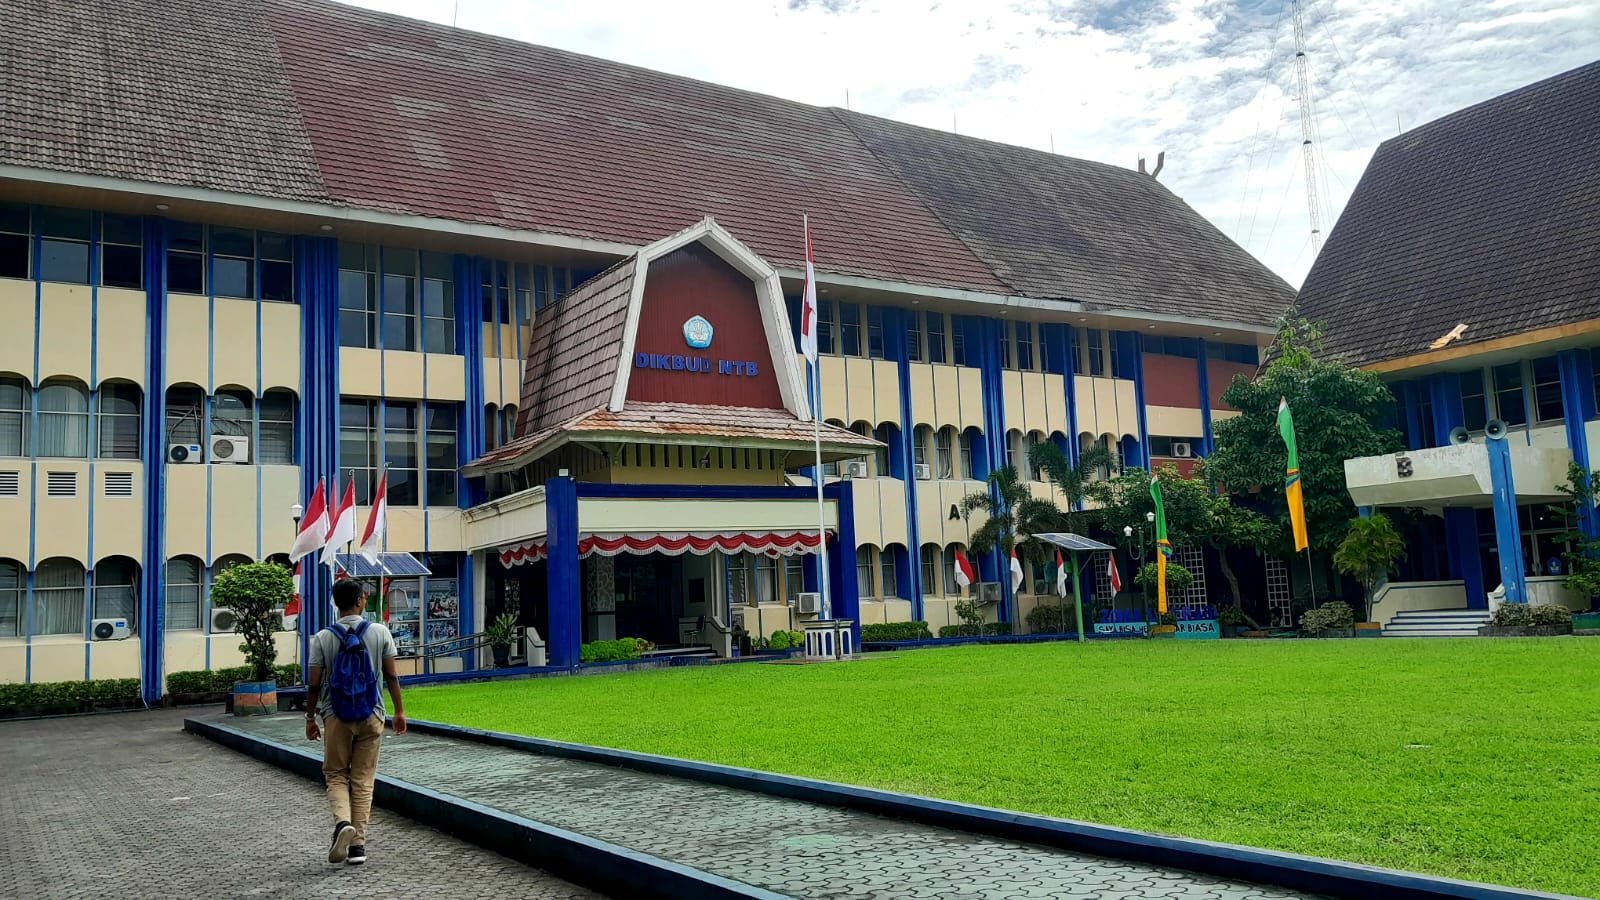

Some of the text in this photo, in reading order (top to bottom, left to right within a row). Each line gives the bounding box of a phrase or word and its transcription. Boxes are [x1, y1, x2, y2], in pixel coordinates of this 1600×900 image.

[635, 352, 759, 377] DIKBUD NTB
[1395, 456, 1414, 478] B
[948, 503, 961, 521] A
[1187, 622, 1215, 633] BIASA
